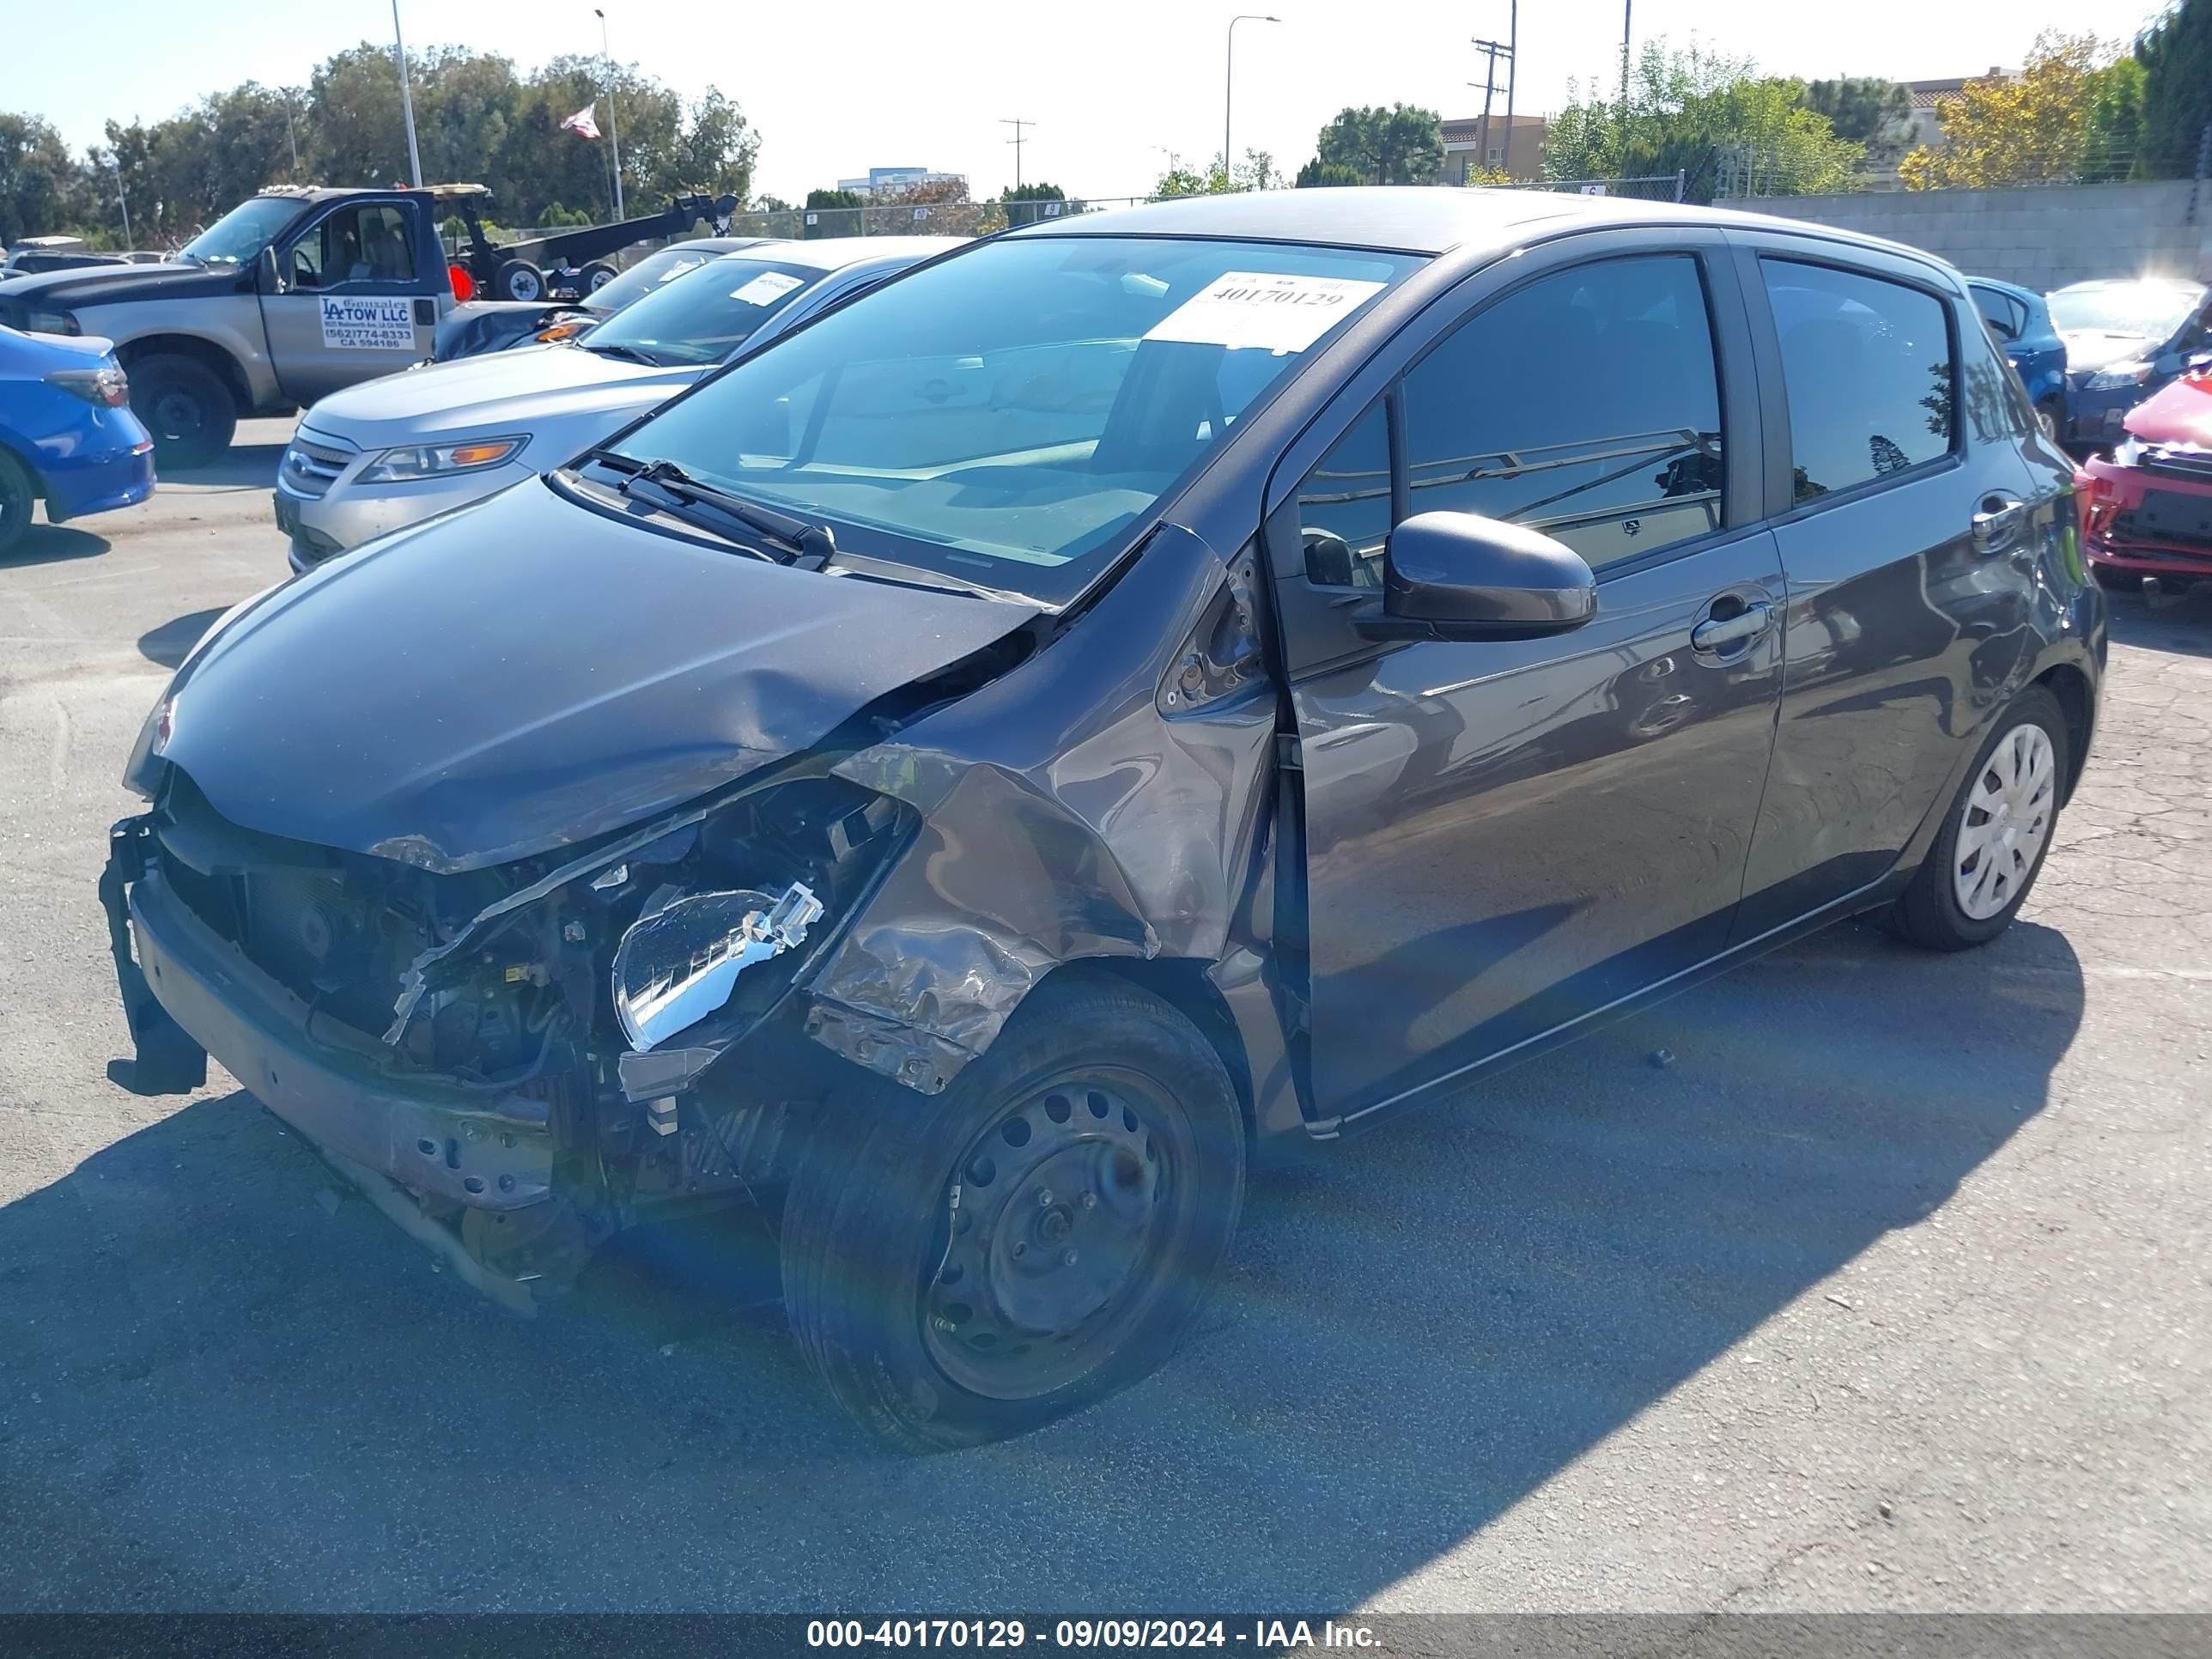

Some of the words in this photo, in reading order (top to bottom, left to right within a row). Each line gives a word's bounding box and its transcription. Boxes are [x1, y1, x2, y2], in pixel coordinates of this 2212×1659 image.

[1212, 288, 1345, 307] 40170129
[323, 298, 344, 320] LA
[344, 309, 377, 321] TOW
[382, 309, 409, 322] LLC
[325, 329, 411, 339] (562)774-8333
[340, 338, 356, 347] CA
